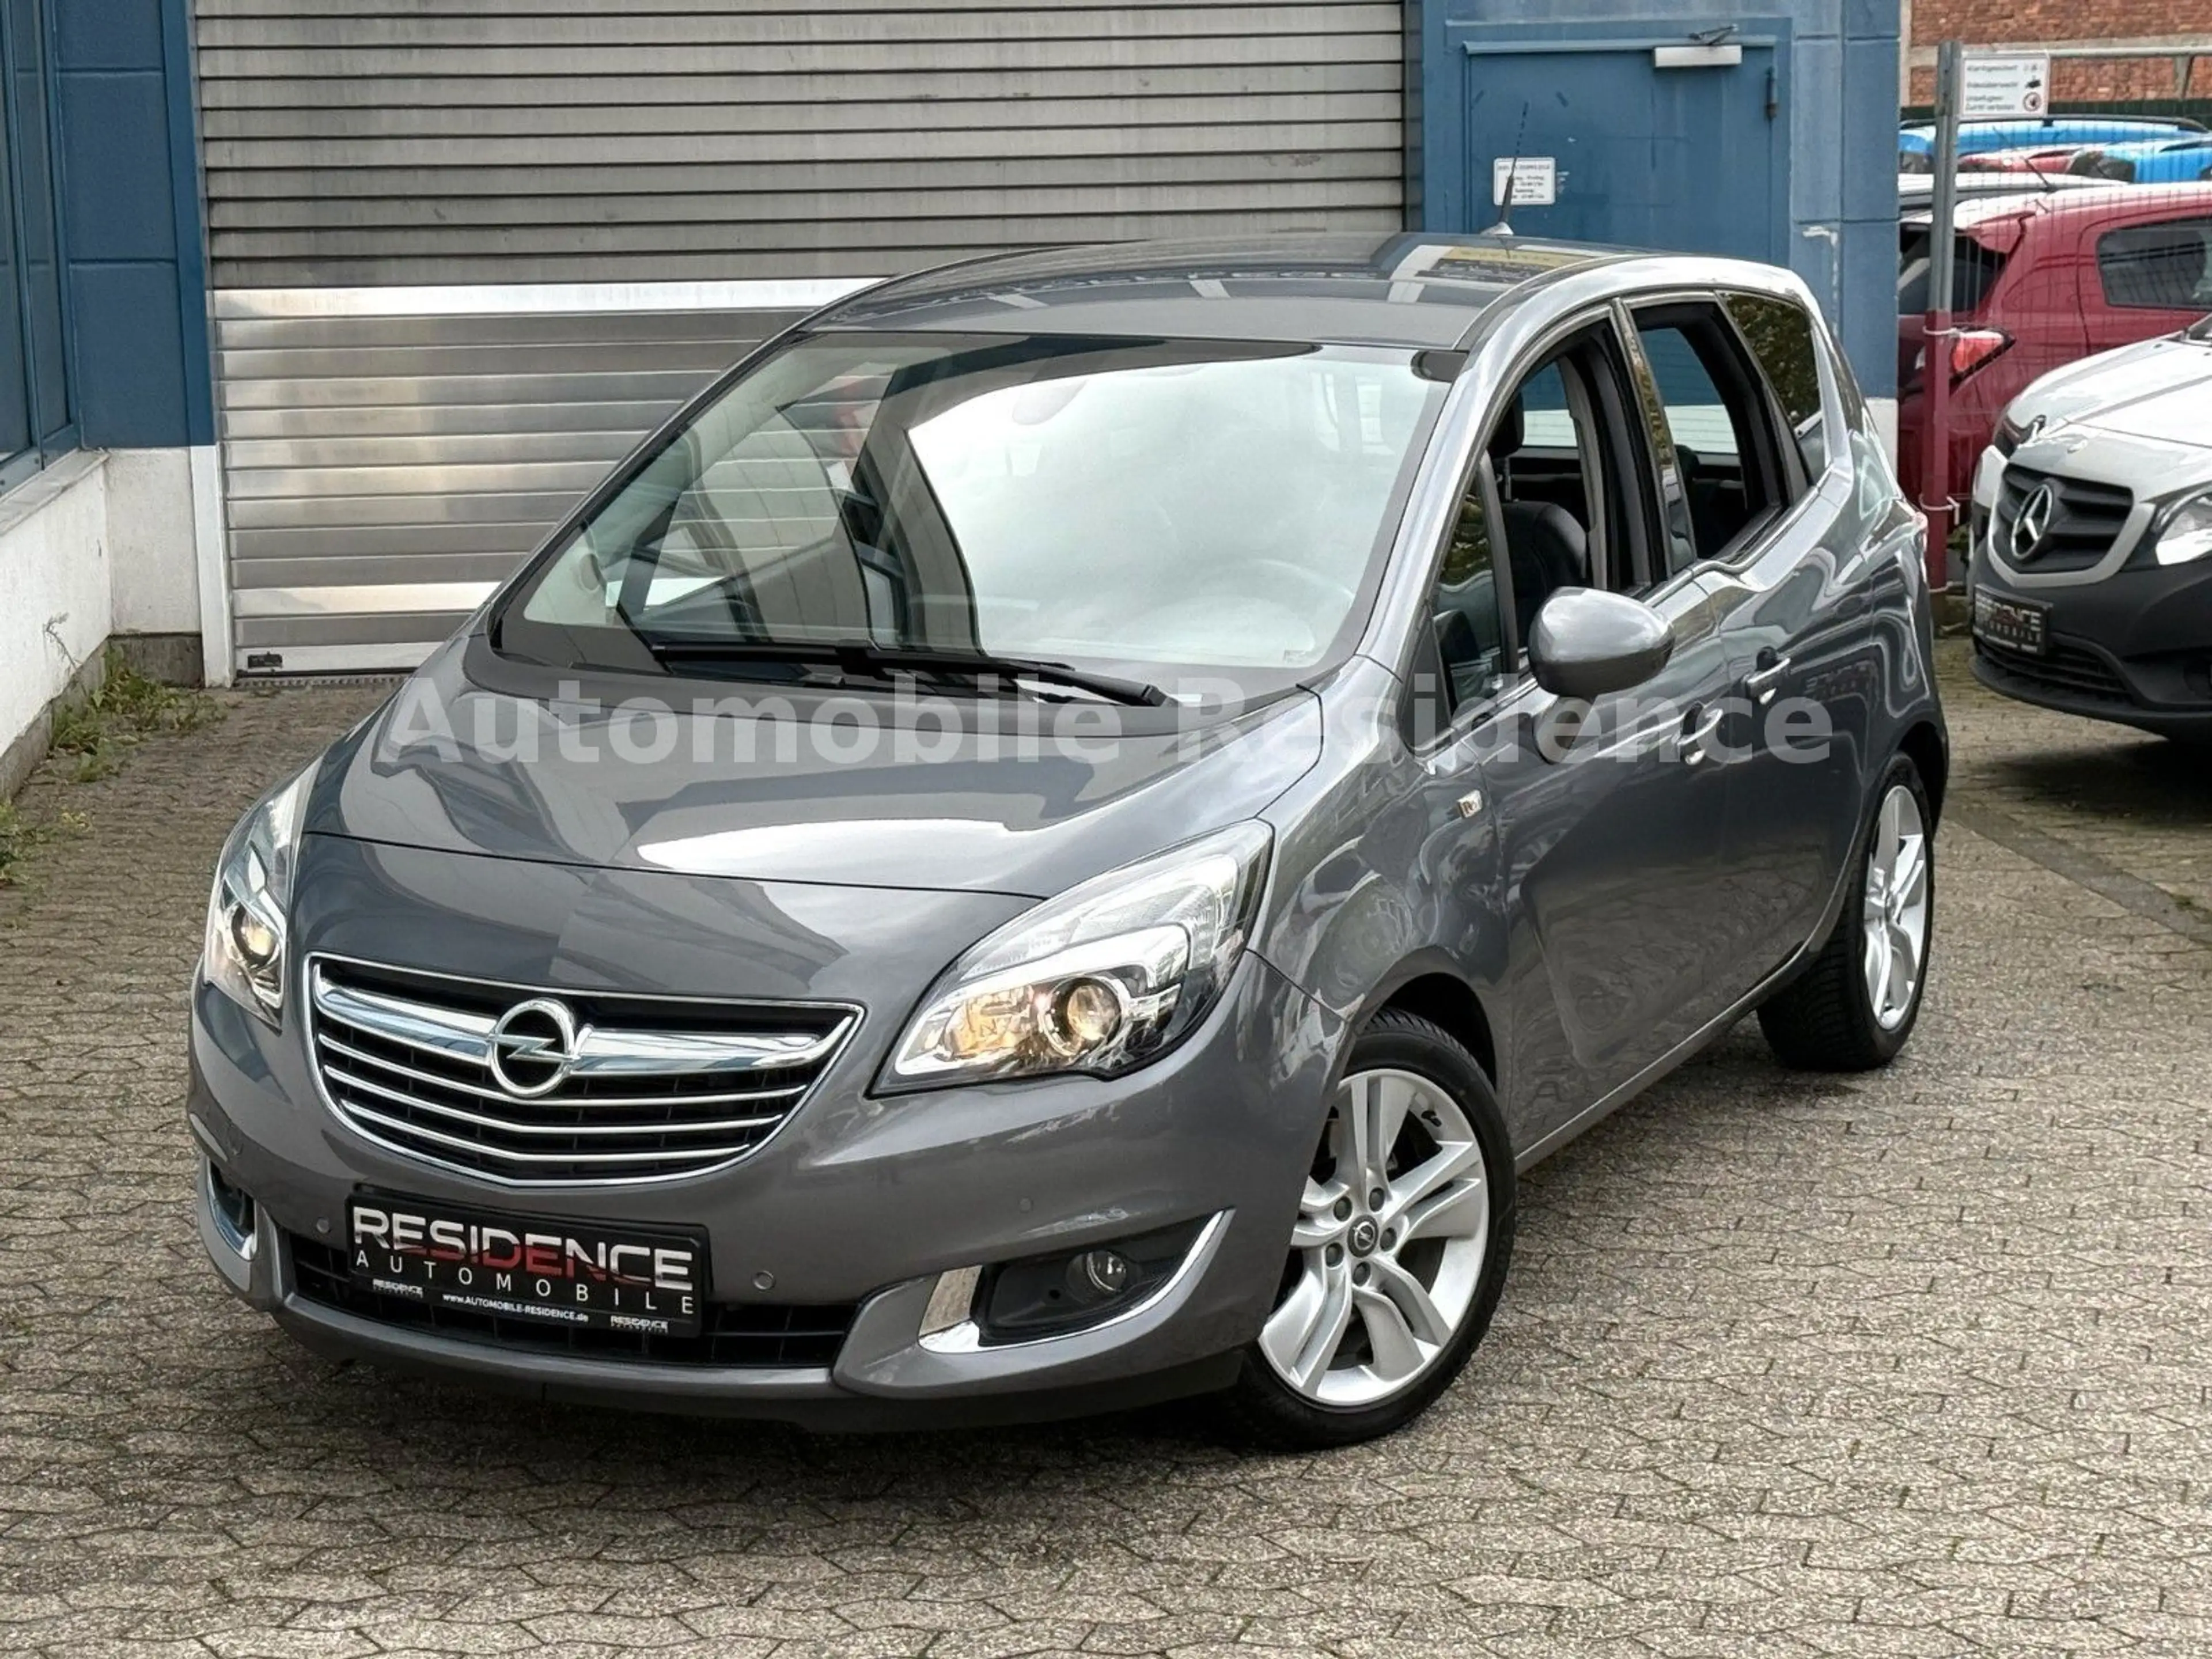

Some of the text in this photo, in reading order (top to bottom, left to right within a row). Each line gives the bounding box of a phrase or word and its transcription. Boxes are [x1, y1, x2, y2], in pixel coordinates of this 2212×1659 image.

[353, 1206, 692, 1291] RESIDENCE
[356, 1250, 694, 1314] AUTOMOBILE
[442, 1293, 589, 1323] www.AUTOMOBILE-RESIDENCE.de
